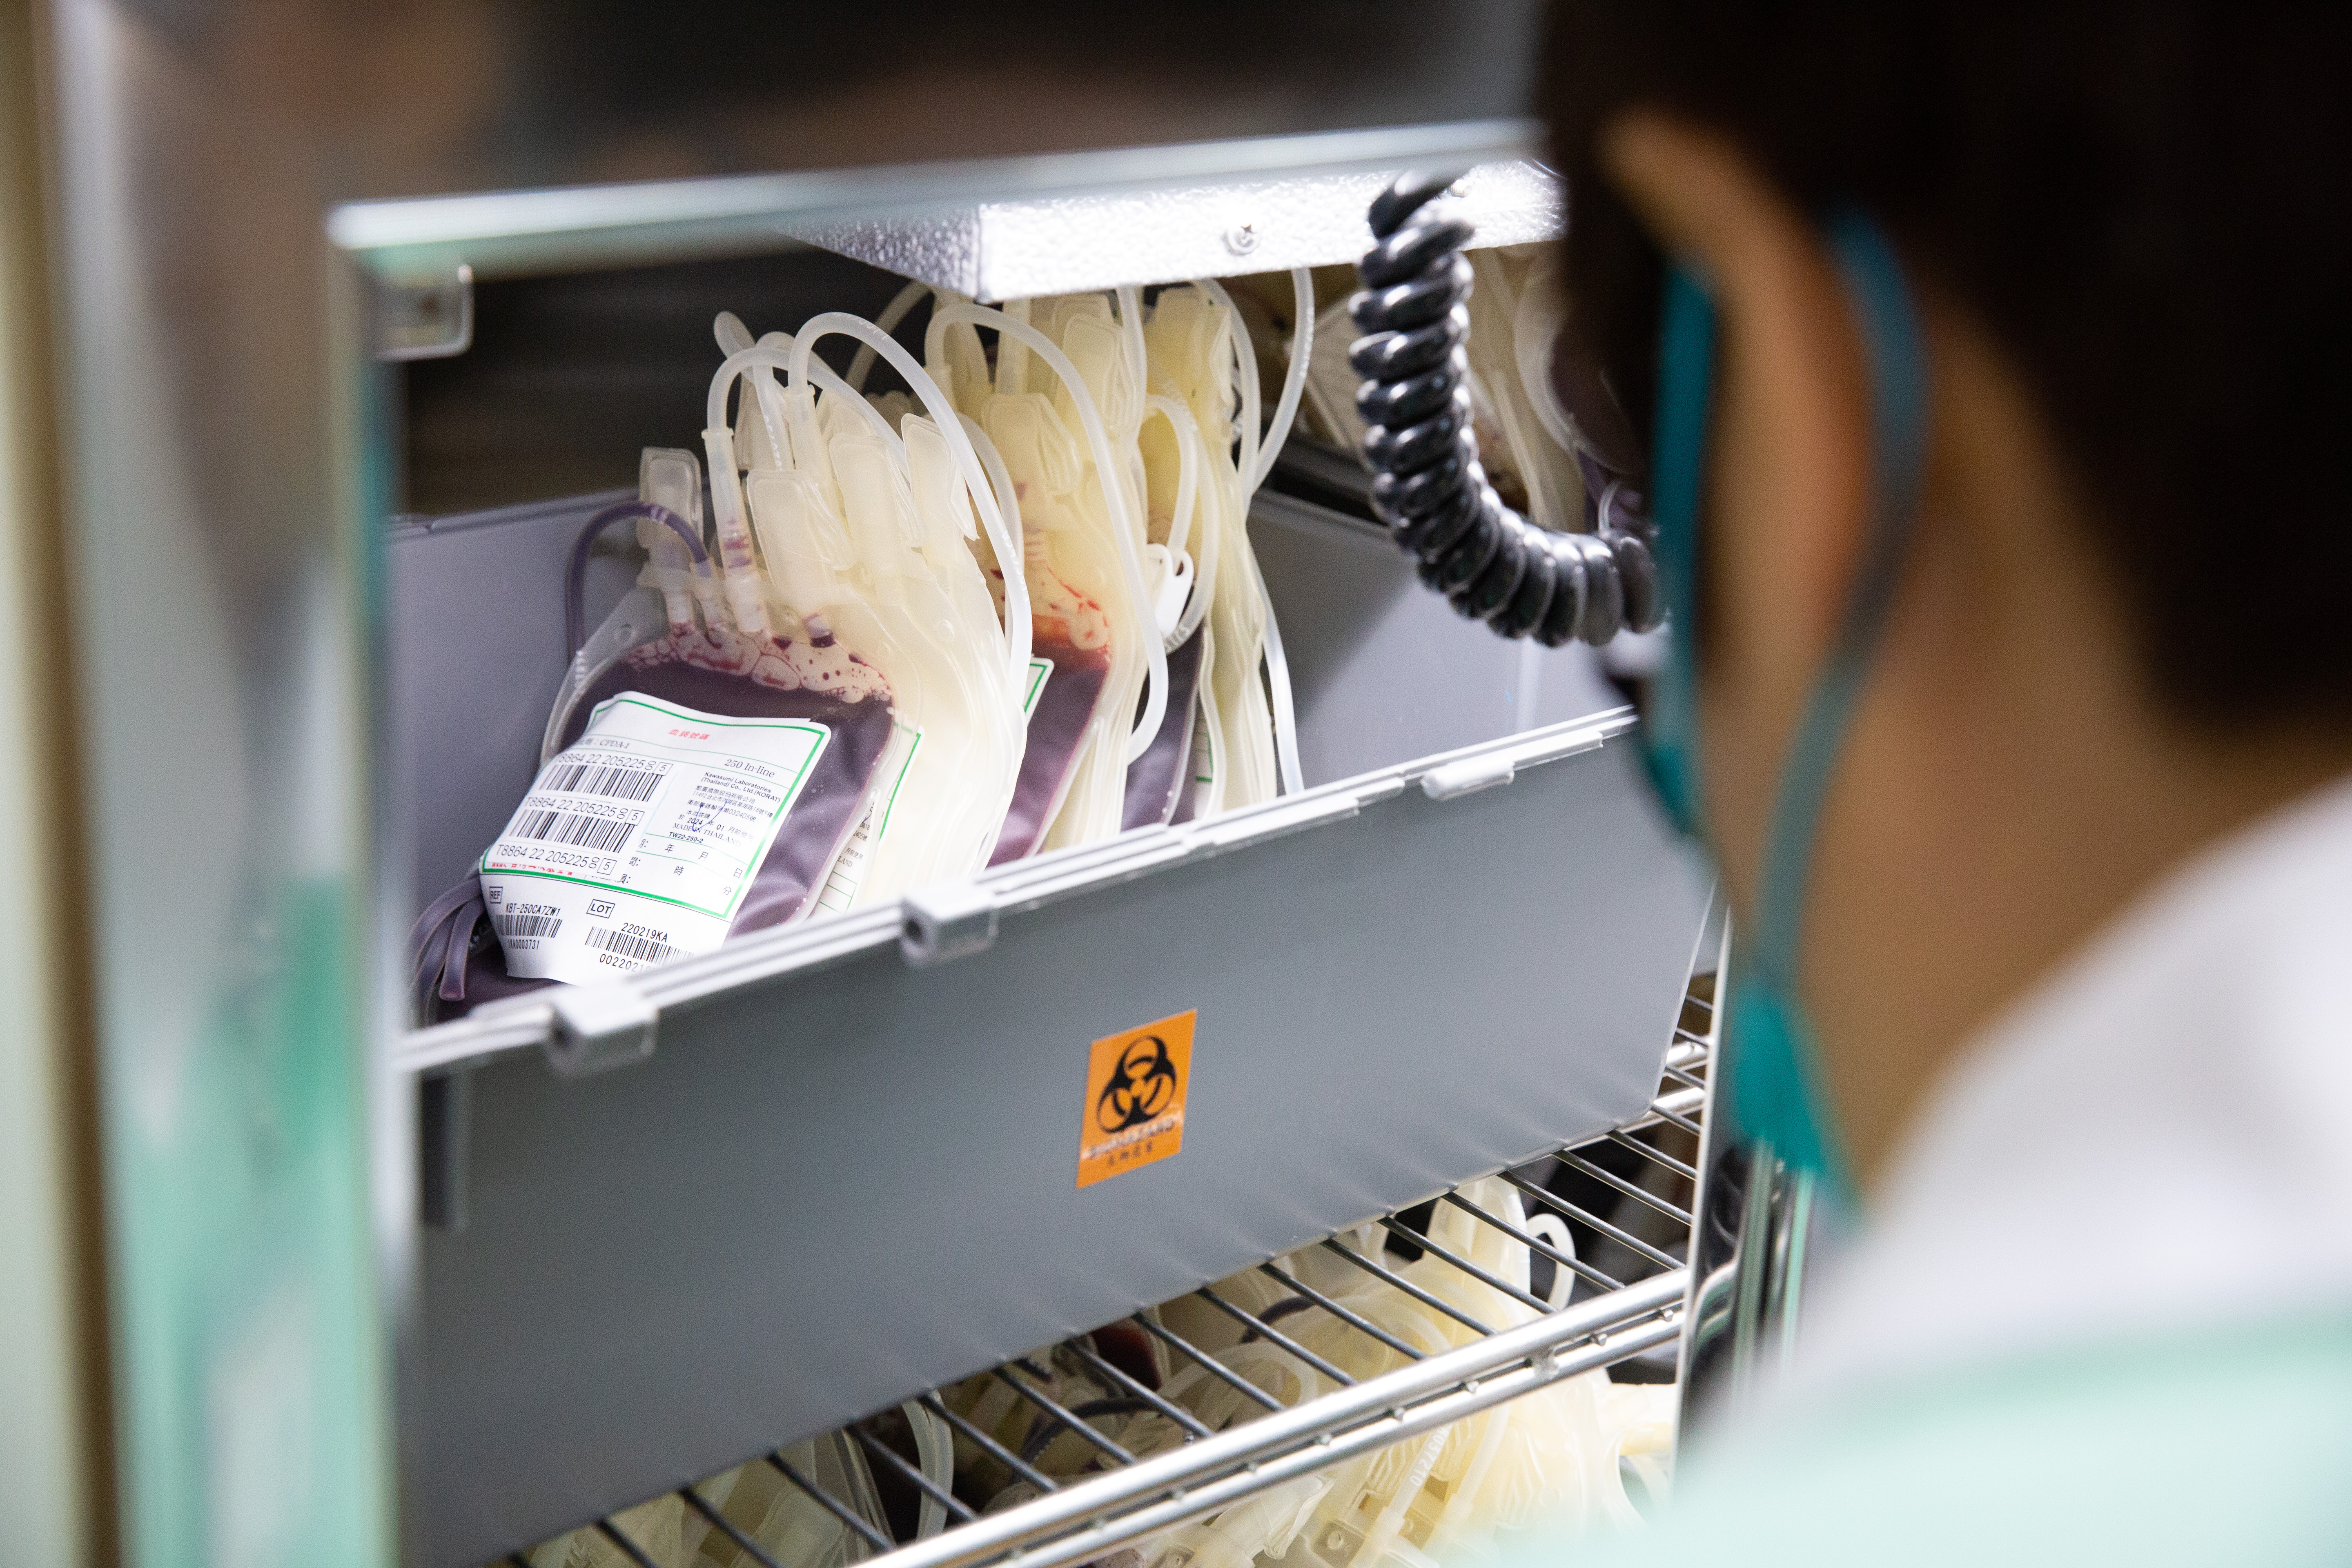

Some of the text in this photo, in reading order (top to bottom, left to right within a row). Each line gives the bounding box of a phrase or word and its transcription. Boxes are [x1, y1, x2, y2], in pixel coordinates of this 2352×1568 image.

[586, 754, 601, 764] 22
[724, 759, 775, 778] 250 In-line
[701, 777, 730, 787] (Thailand)
[704, 771, 771, 793] Kawasumi Laboratories
[557, 800, 572, 810] 22
[687, 817, 703, 826] 2024
[669, 831, 704, 843] TW22-250-2
[673, 822, 693, 832] MADE
[704, 829, 741, 847] THAILAND
[496, 844, 528, 858] T8864
[529, 848, 545, 860] 22
[603, 862, 611, 870] 5
[665, 844, 675, 853] 年
[698, 851, 708, 861] 月
[733, 868, 743, 878] 日
[490, 891, 501, 899] REF
[722, 886, 732, 895] 分
[590, 903, 612, 914] LOT
[621, 922, 668, 942] 220219KA
